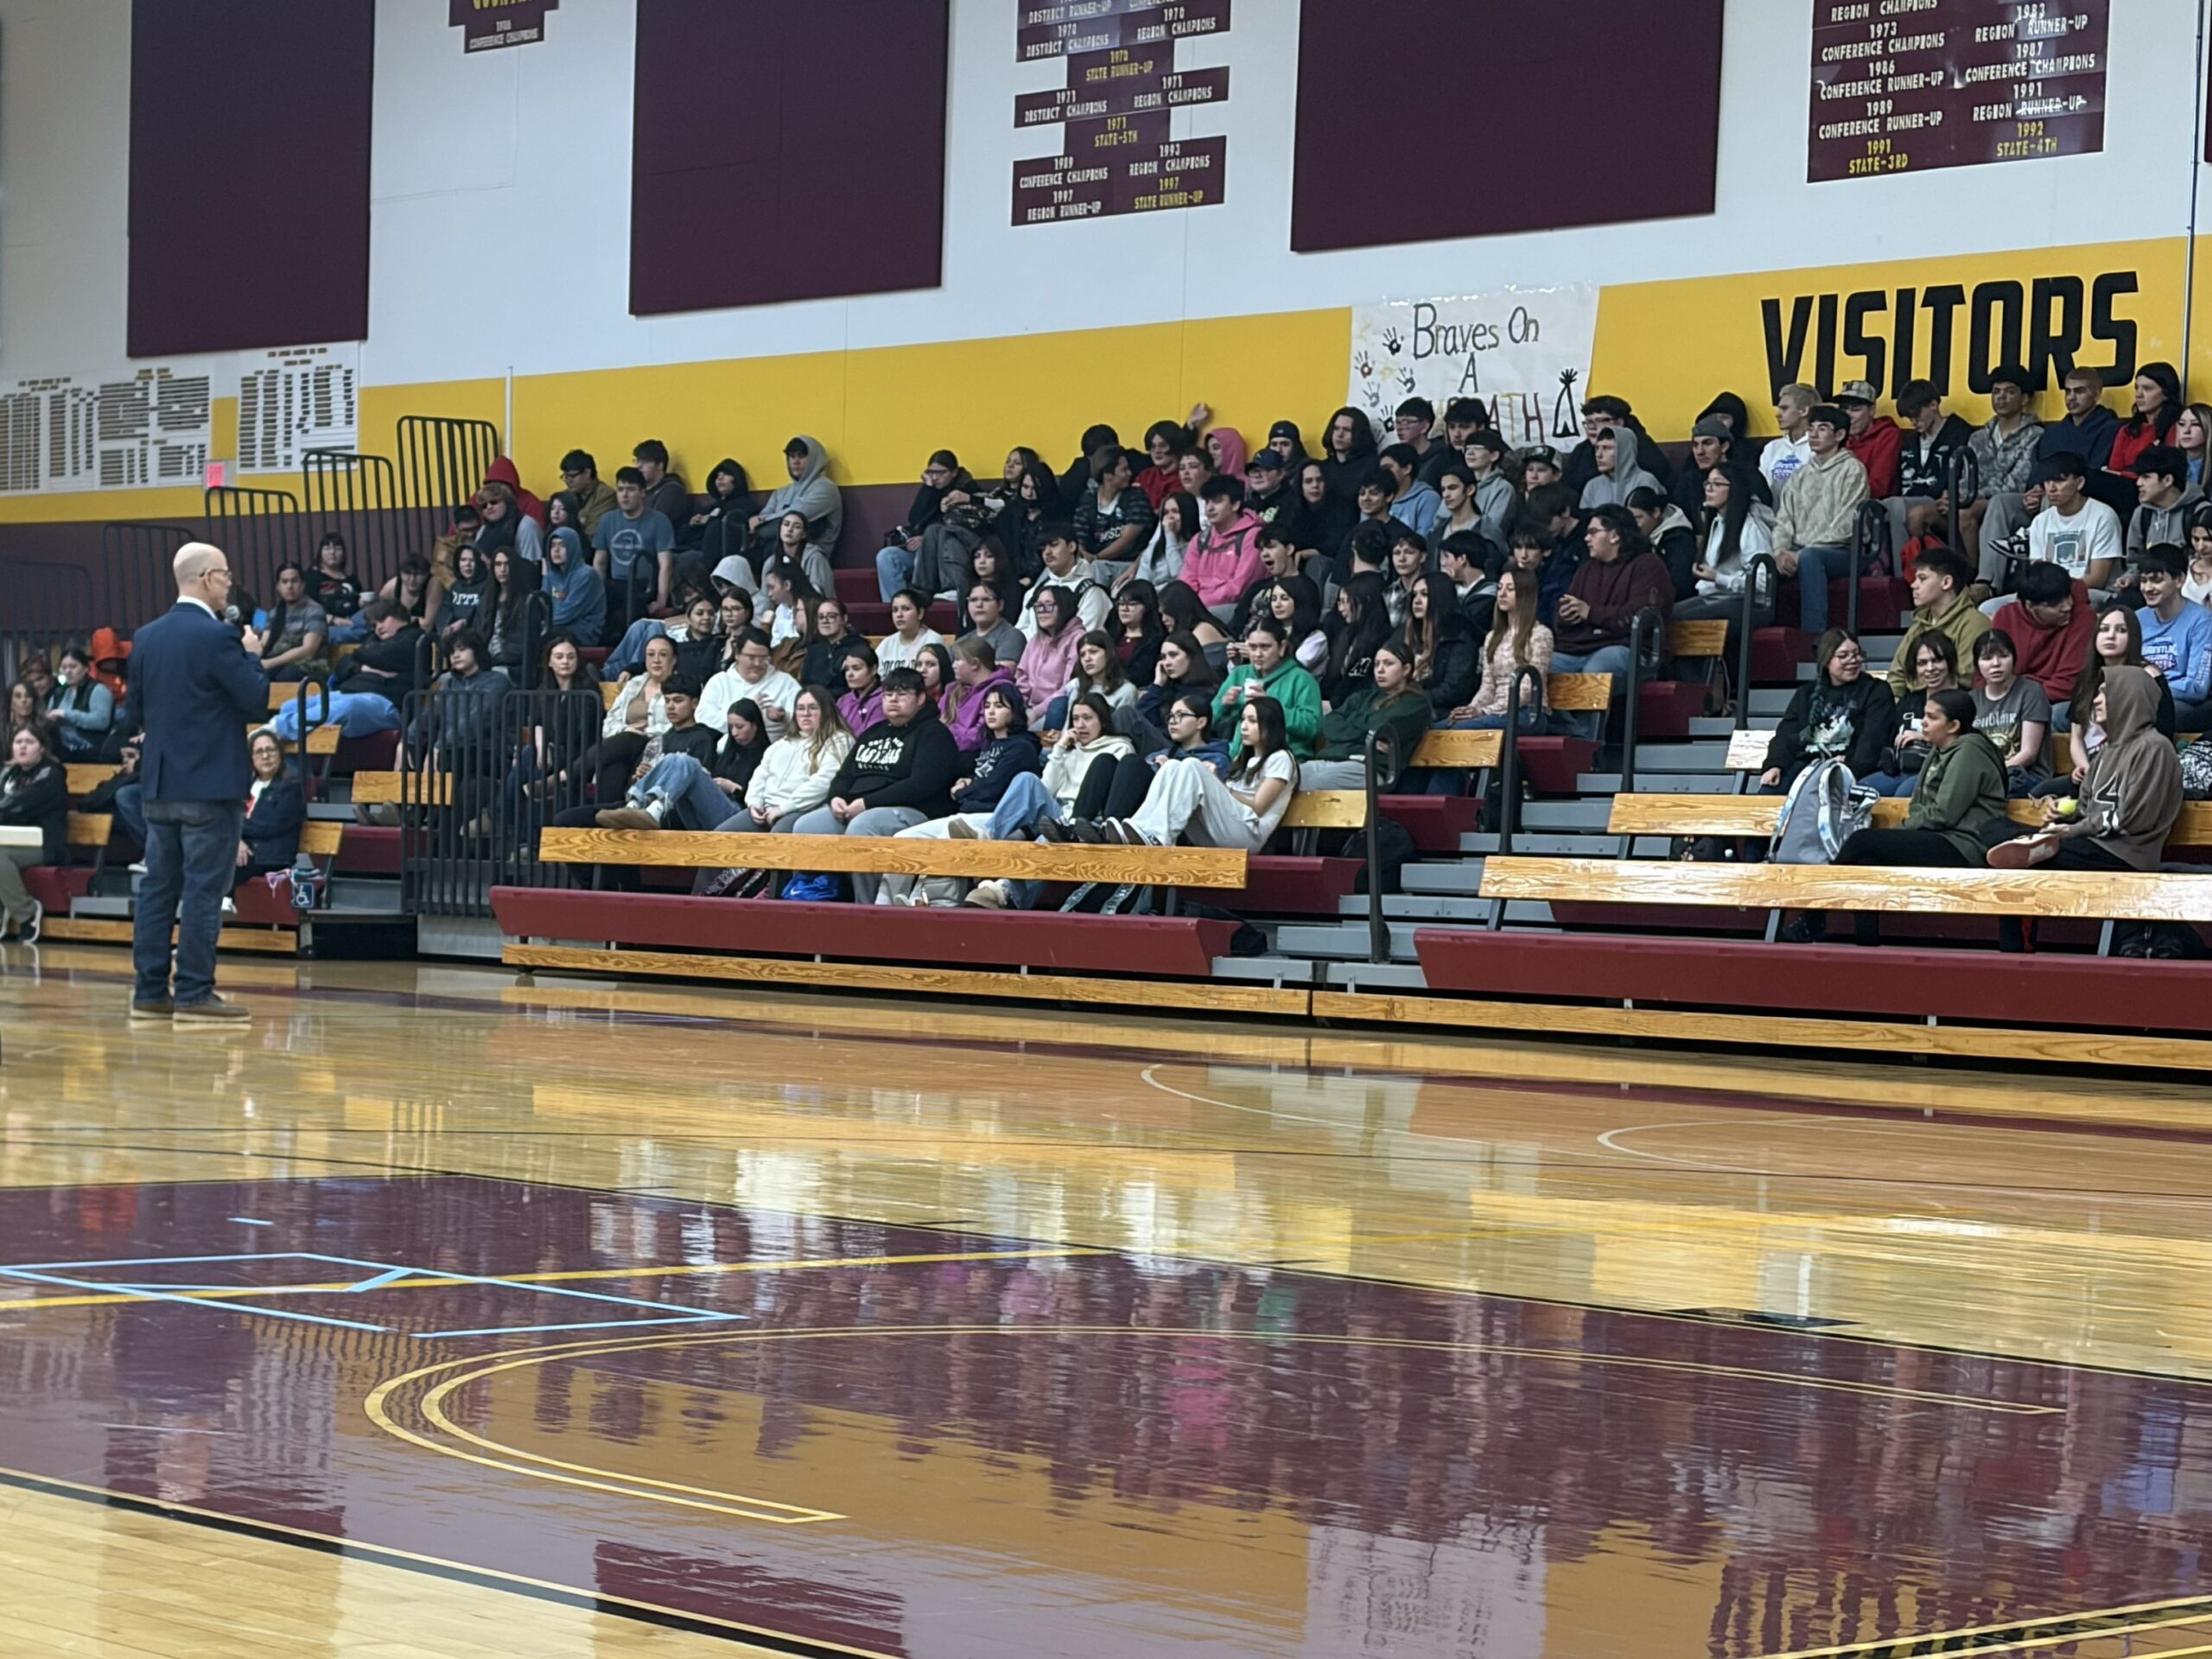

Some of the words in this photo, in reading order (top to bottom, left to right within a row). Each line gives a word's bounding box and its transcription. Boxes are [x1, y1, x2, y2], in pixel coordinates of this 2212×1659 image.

[1028, 6, 1065, 24] DISTRICT
[1163, 6, 1185, 22] 1970
[1831, 3, 1870, 22] REGION
[1880, 0, 1938, 15] CHAMPIONS
[2016, 3, 2046, 21] 1983
[1058, 22, 1077, 38] 1970
[1136, 24, 1166, 41] REGION
[1172, 16, 1217, 35] CHAMPIONS
[1869, 22, 1897, 39] 1973
[1975, 23, 2016, 42] REGION
[2027, 15, 2088, 35] RUNNER-UP
[1026, 40, 1063, 58] DISTRICT
[1069, 34, 1110, 51] CHAMPIONS
[1821, 40, 1884, 62] CONFERENCE
[1888, 32, 1946, 54] CHAMPIONS
[2016, 41, 2044, 59] 1987
[1085, 66, 1108, 81] STATE
[1110, 60, 1154, 78] RUNNER-UP
[1869, 60, 1896, 78] 1986
[1965, 61, 2028, 83] CONFERENCE
[2035, 54, 2096, 74] CHAMPIONS
[1162, 74, 1183, 90] 1971
[1820, 79, 1883, 101] CONFERENCE
[1887, 71, 1945, 92] RUNNER-UP
[2013, 81, 2043, 99] 1991
[1056, 90, 1077, 105] 1971
[1134, 92, 1162, 109] REGION
[1168, 86, 1213, 104] CHAMPIONS
[1024, 106, 1061, 124] DISTRICT
[1066, 99, 1108, 118] CHAMPIONS
[1866, 99, 1894, 118] 1989
[1973, 103, 2013, 122] REGION
[2020, 95, 2084, 117] RUNNER-UP
[1107, 116, 1127, 131] 1971
[1819, 118, 1880, 140] CONFERENCE
[1886, 111, 1943, 132] RUNNER-UP
[2017, 121, 2044, 138] 1992
[1160, 143, 1181, 157] 1993
[1866, 138, 1891, 156] 1991
[1997, 137, 2058, 156] STATE-4TH
[1128, 161, 1159, 176] REGION
[1166, 155, 1211, 172] CHAMPIONS
[1848, 153, 1909, 175] STATE-3RD
[1020, 172, 1064, 189] CONFERENCE
[1067, 167, 1109, 184] CHAMPIONS
[1052, 188, 1074, 204] 1997
[1134, 194, 1158, 210] STATE
[1160, 189, 1205, 207] RUNNER-UP
[1027, 206, 1056, 221] REGION
[1060, 200, 1103, 218] RUNNER-UP
[1413, 302, 1500, 360] Braves
[1508, 306, 1540, 345] On
[1761, 270, 2139, 406] VISITORS
[1457, 351, 1479, 394] A
